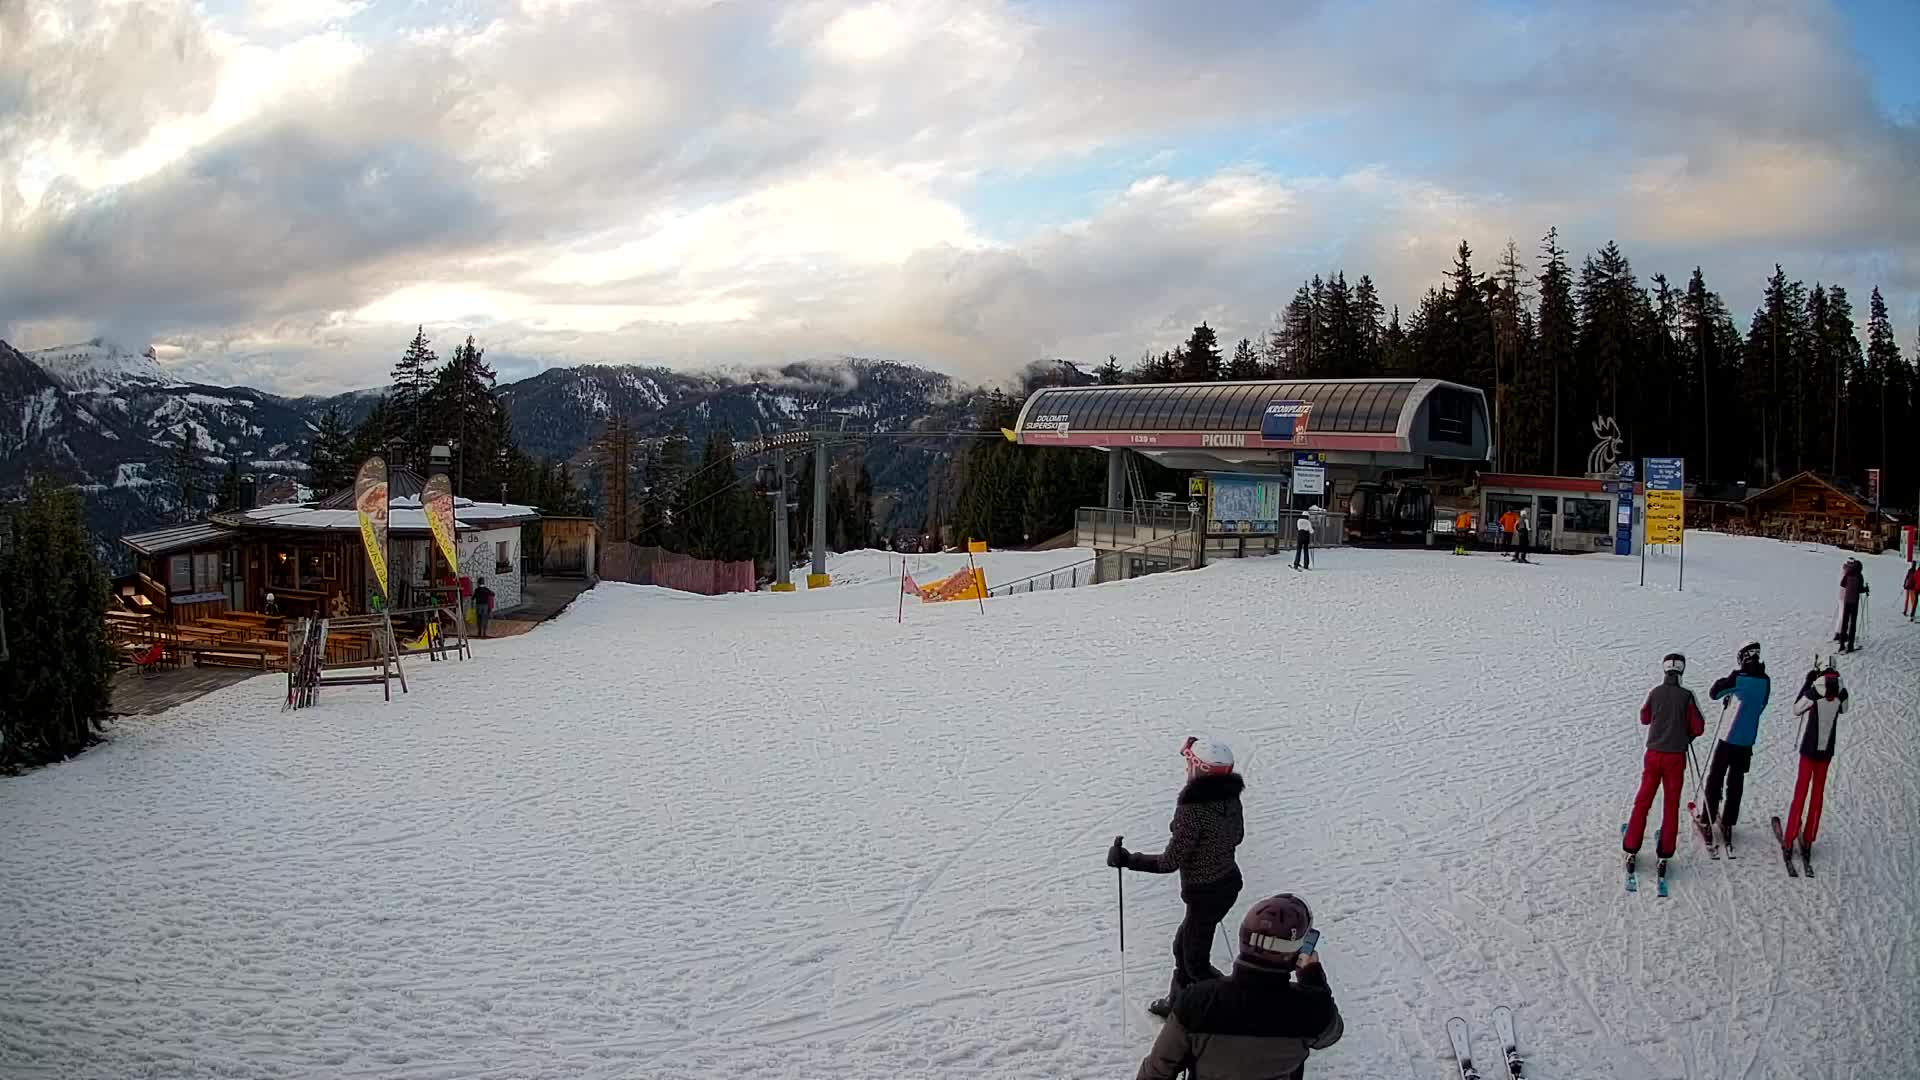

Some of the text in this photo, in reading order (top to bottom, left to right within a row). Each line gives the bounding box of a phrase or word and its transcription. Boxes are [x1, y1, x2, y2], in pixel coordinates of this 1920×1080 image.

[1266, 405, 1311, 414] KRONPLATZ
[1036, 415, 1069, 423] DOLOMITI
[1025, 422, 1059, 430] SUPERSKI
[1201, 434, 1246, 447] PICULIN
